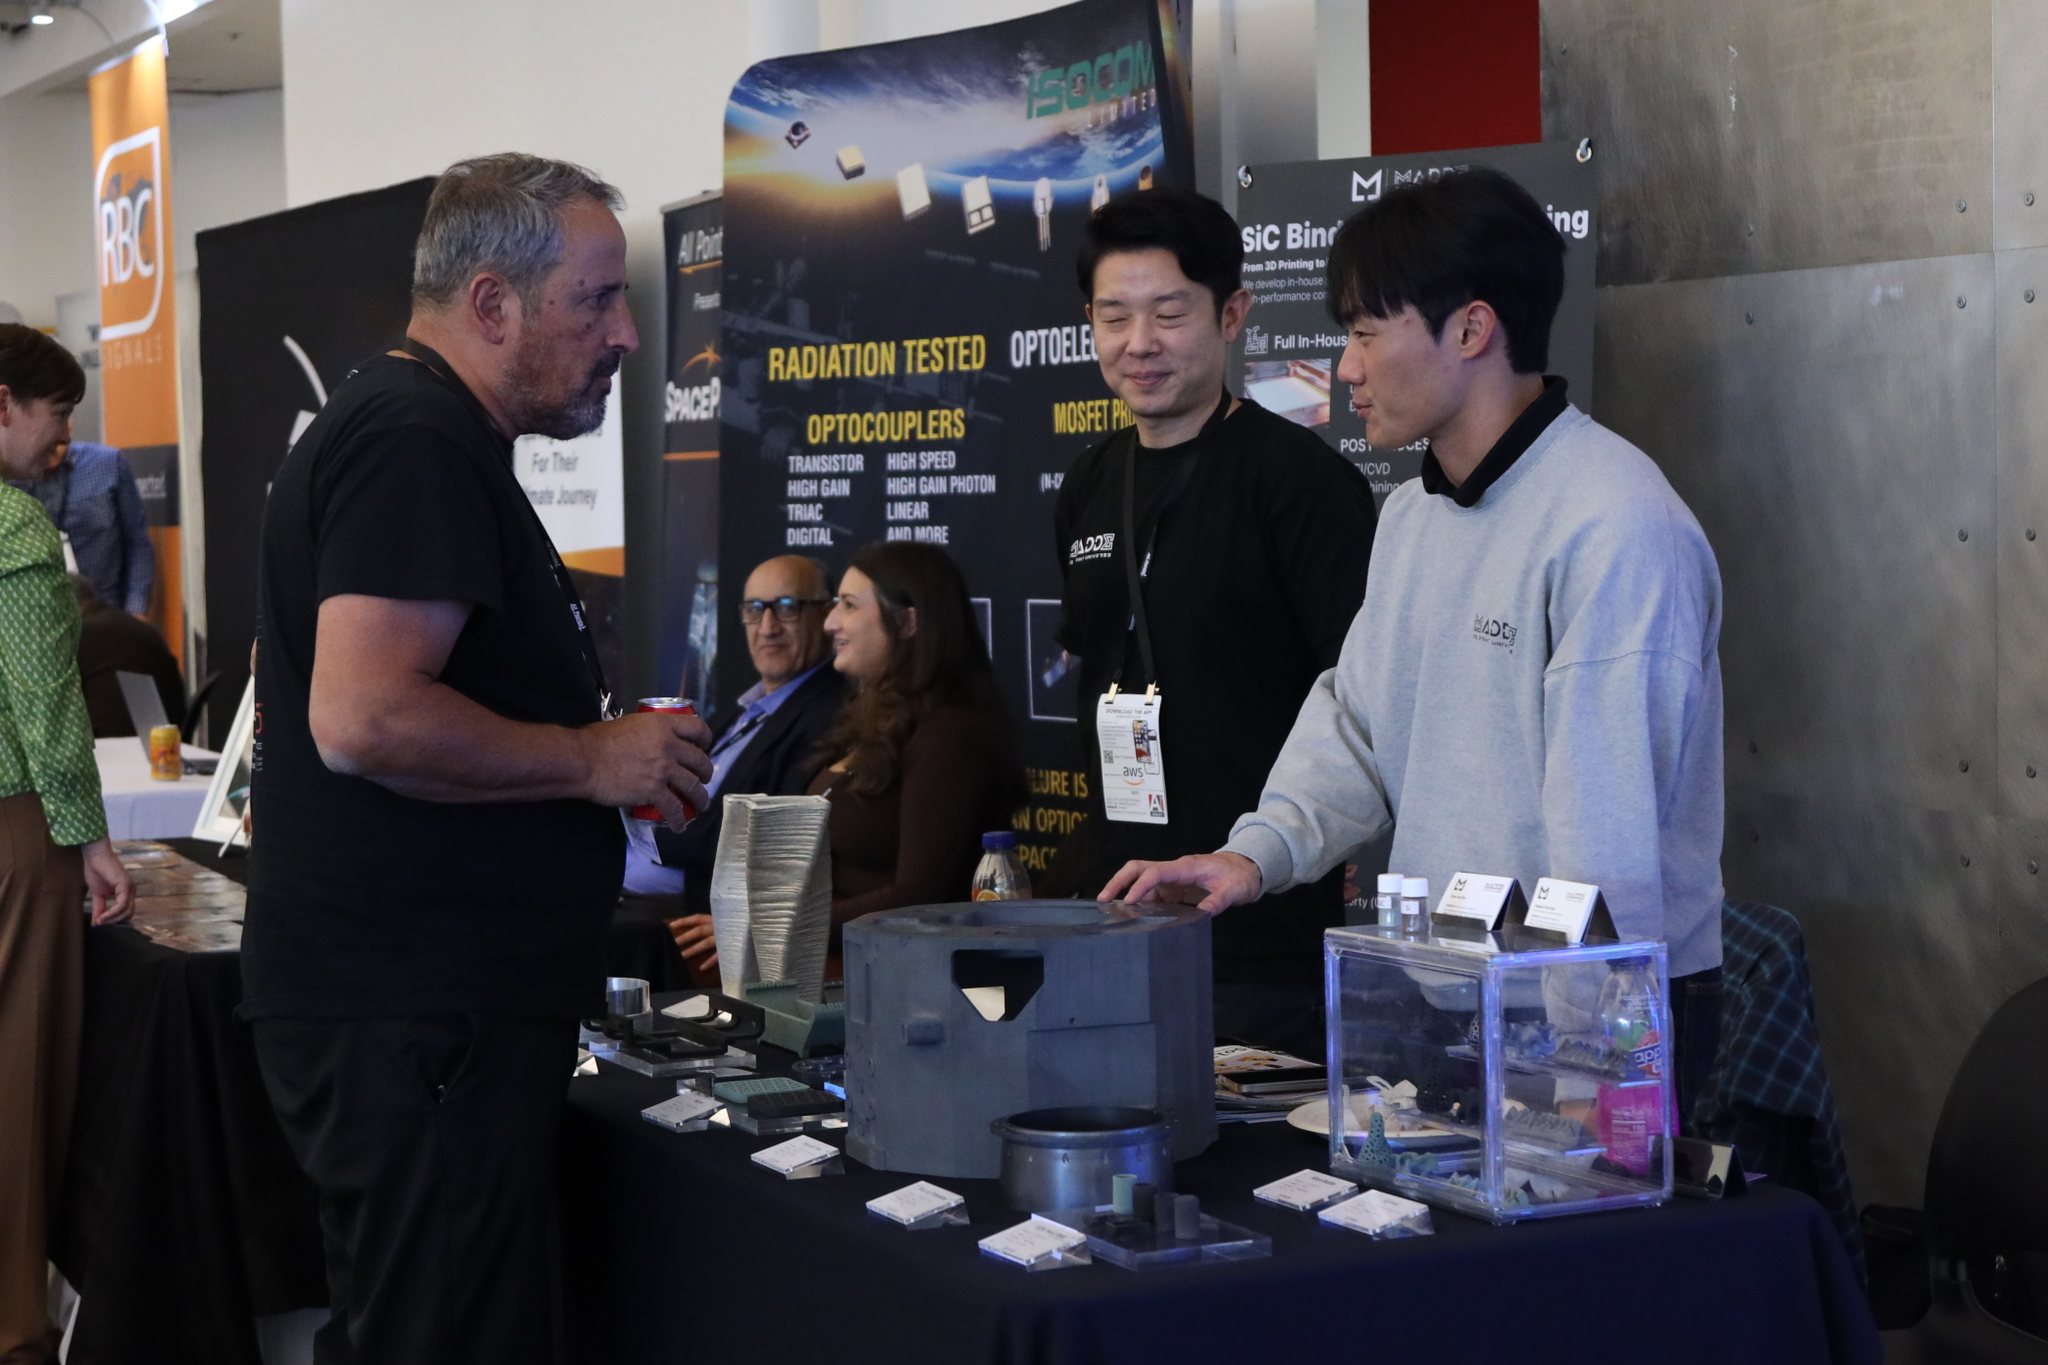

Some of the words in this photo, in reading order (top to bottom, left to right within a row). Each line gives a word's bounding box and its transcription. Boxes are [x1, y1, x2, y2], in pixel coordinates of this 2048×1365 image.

[1026, 40, 1156, 121] ISOCOM
[1394, 164, 1469, 187] MAD
[101, 187, 155, 288] RBC
[1242, 223, 1281, 253] SiC
[1242, 262, 1264, 273] From
[1265, 260, 1278, 271] 3D
[1278, 258, 1315, 271] Printing
[1315, 258, 1326, 268] to
[1255, 278, 1286, 290] develop
[1287, 276, 1324, 287] in-house
[1274, 335, 1297, 350] Full
[768, 341, 896, 381] RADIATION
[903, 334, 986, 374] TESTED
[807, 408, 966, 445] OPTOCOUPLERS
[1054, 399, 1110, 433] MOSFET
[532, 451, 550, 472] For
[552, 451, 580, 472] Their
[787, 453, 865, 474] TRANSISTOR
[887, 452, 917, 471] HIGH
[918, 450, 957, 470] SPEED
[787, 479, 818, 498] HIGH
[820, 478, 850, 497] GAIN
[886, 476, 917, 496] HIGH
[918, 475, 948, 494] GAIN
[949, 474, 996, 494] PHOTON
[787, 503, 824, 522] TRIAC
[886, 500, 930, 520] LINEAR
[786, 527, 834, 547] DIGITAL
[886, 525, 913, 542] AND
[914, 525, 949, 544] MORE
[1123, 766, 1145, 778] aws
[1074, 772, 1088, 798] IS
[1036, 807, 1088, 835] OPTI
